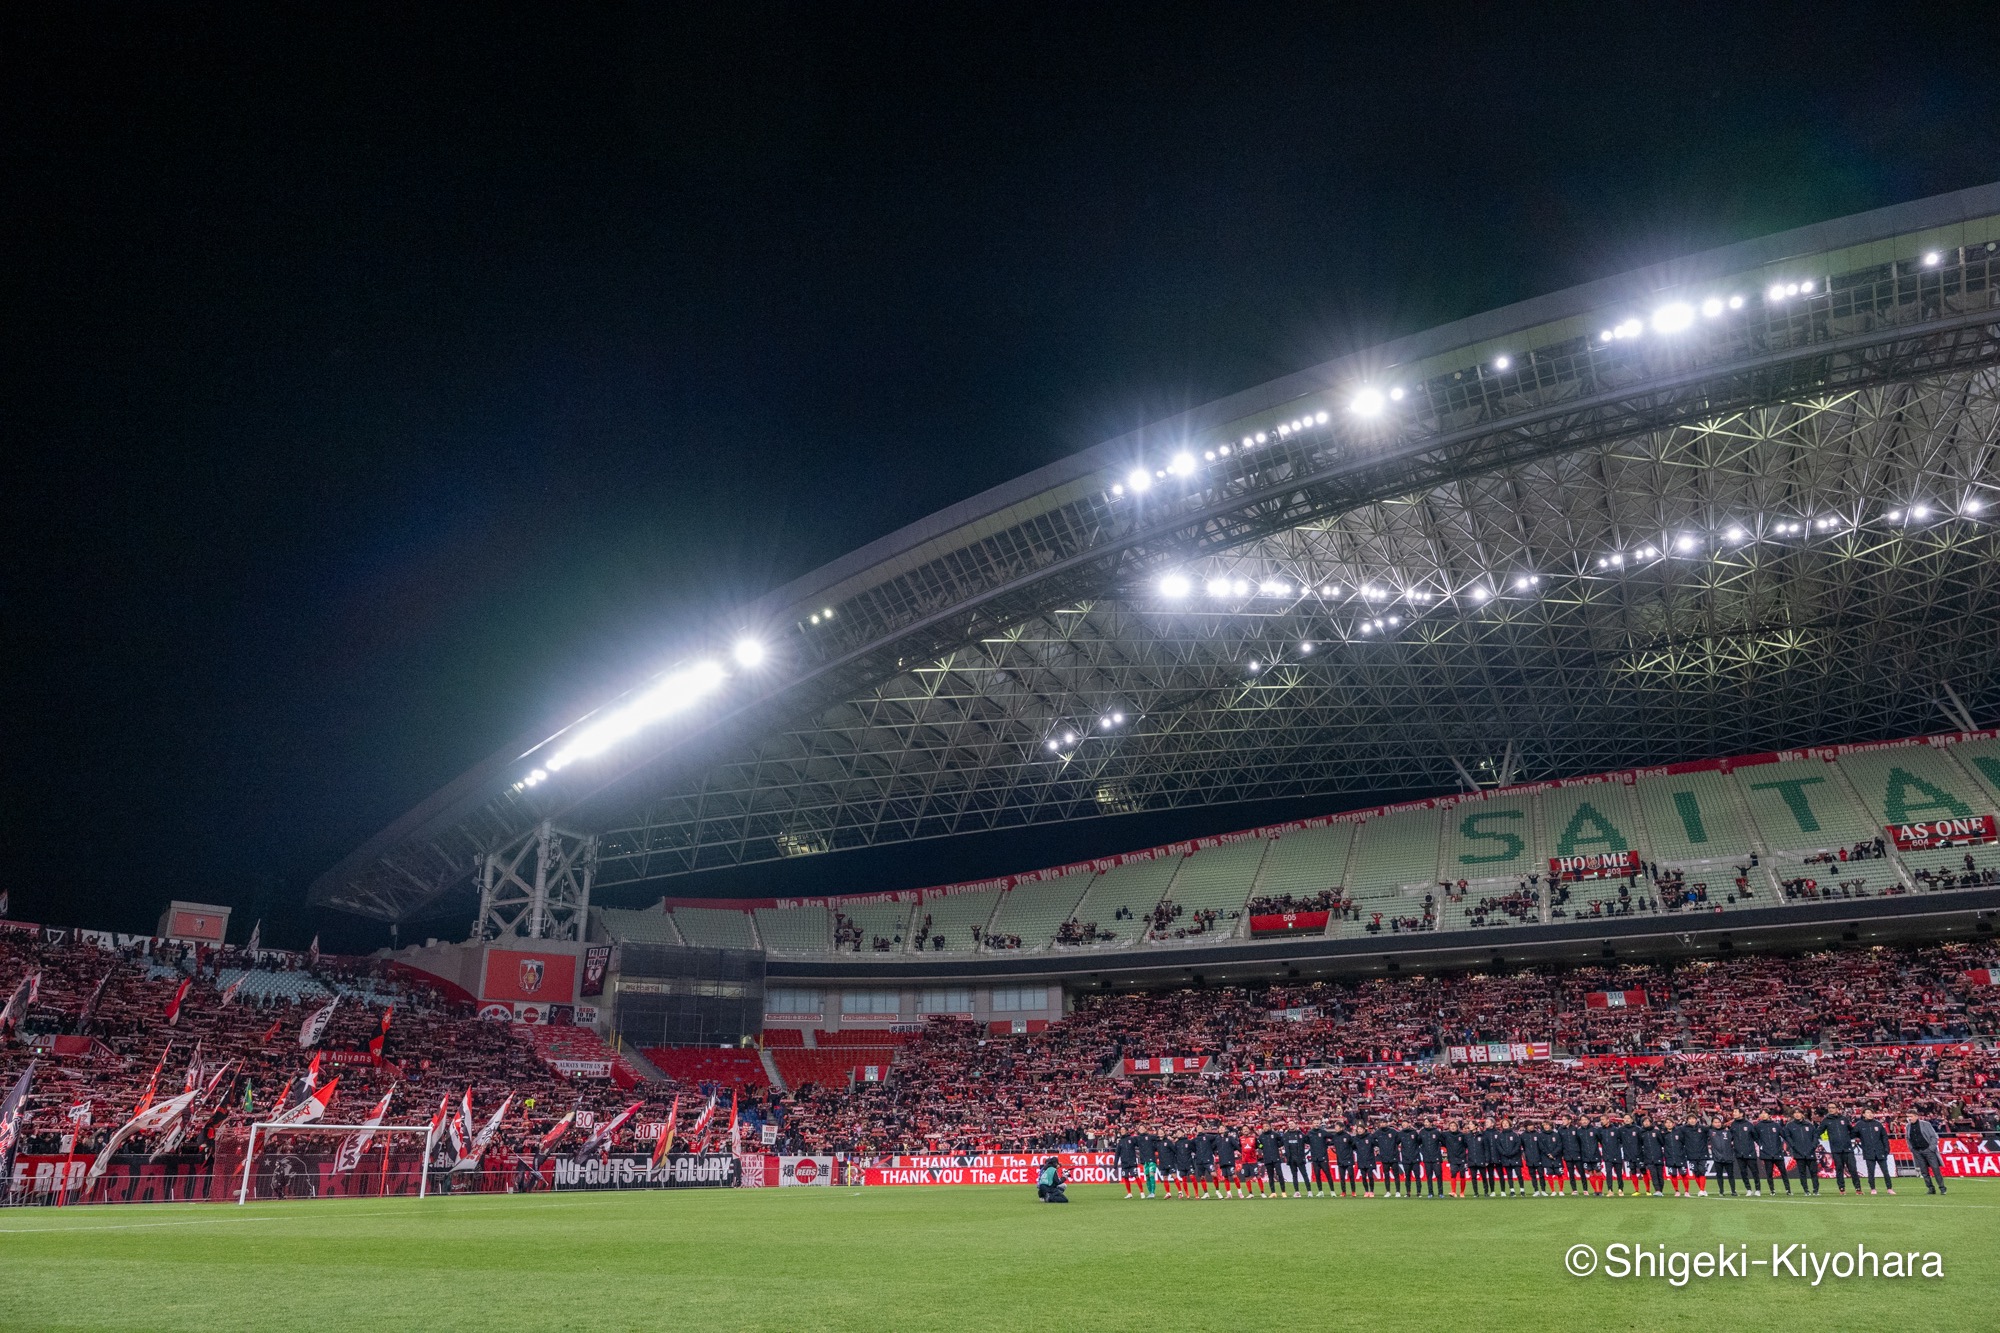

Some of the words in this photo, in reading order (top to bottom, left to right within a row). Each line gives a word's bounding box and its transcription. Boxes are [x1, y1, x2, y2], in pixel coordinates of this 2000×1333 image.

[1777, 750, 1803, 763] We
[1807, 747, 1835, 761] Are
[1838, 738, 1920, 755] Diamonds
[1928, 734, 1956, 749] We
[1962, 731, 1990, 742] Are
[1432, 796, 1455, 807] Yes
[1459, 791, 1483, 803] Red
[1487, 783, 1553, 800] Diamonds
[1606, 771, 1632, 784] The
[1197, 838, 1217, 849] We
[1221, 830, 1255, 845] Stand
[1259, 822, 1300, 839] Beside
[1304, 818, 1326, 830] You
[1332, 809, 1379, 824] Forever
[1383, 801, 1427, 817] Always
[1899, 822, 1929, 841] AS
[1935, 817, 1986, 836] ONE
[1912, 839, 1929, 847] 604
[1014, 873, 1036, 885] Yes
[1040, 869, 1059, 881] We
[1062, 864, 1089, 878] Love
[1093, 859, 1114, 871] You
[1121, 852, 1150, 865] Boys
[1168, 841, 1191, 855] Red
[776, 899, 797, 909] We
[803, 899, 824, 909] Are
[828, 893, 892, 908] Diamonds
[897, 891, 918, 902] We
[921, 889, 942, 900] Are
[946, 879, 1008, 895] Diamonds
[1490, 1045, 1508, 1054] 215
[865, 1066, 878, 1074] 213
[1160, 1058, 1173, 1067] 214
[576, 1111, 593, 1127] 30
[636, 1124, 650, 1139] 30
[911, 1156, 960, 1167] THANK
[964, 1156, 993, 1167] YOU
[1001, 1156, 1026, 1167] The
[1946, 1156, 2000, 1173] THA
[555, 1158, 579, 1185] NO
[676, 1157, 731, 1183] GLORY
[796, 1168, 817, 1176] REDS
[881, 1169, 930, 1184] THANK
[933, 1169, 963, 1183] YOU
[970, 1169, 996, 1183] The
[999, 1169, 1028, 1183] ACE
